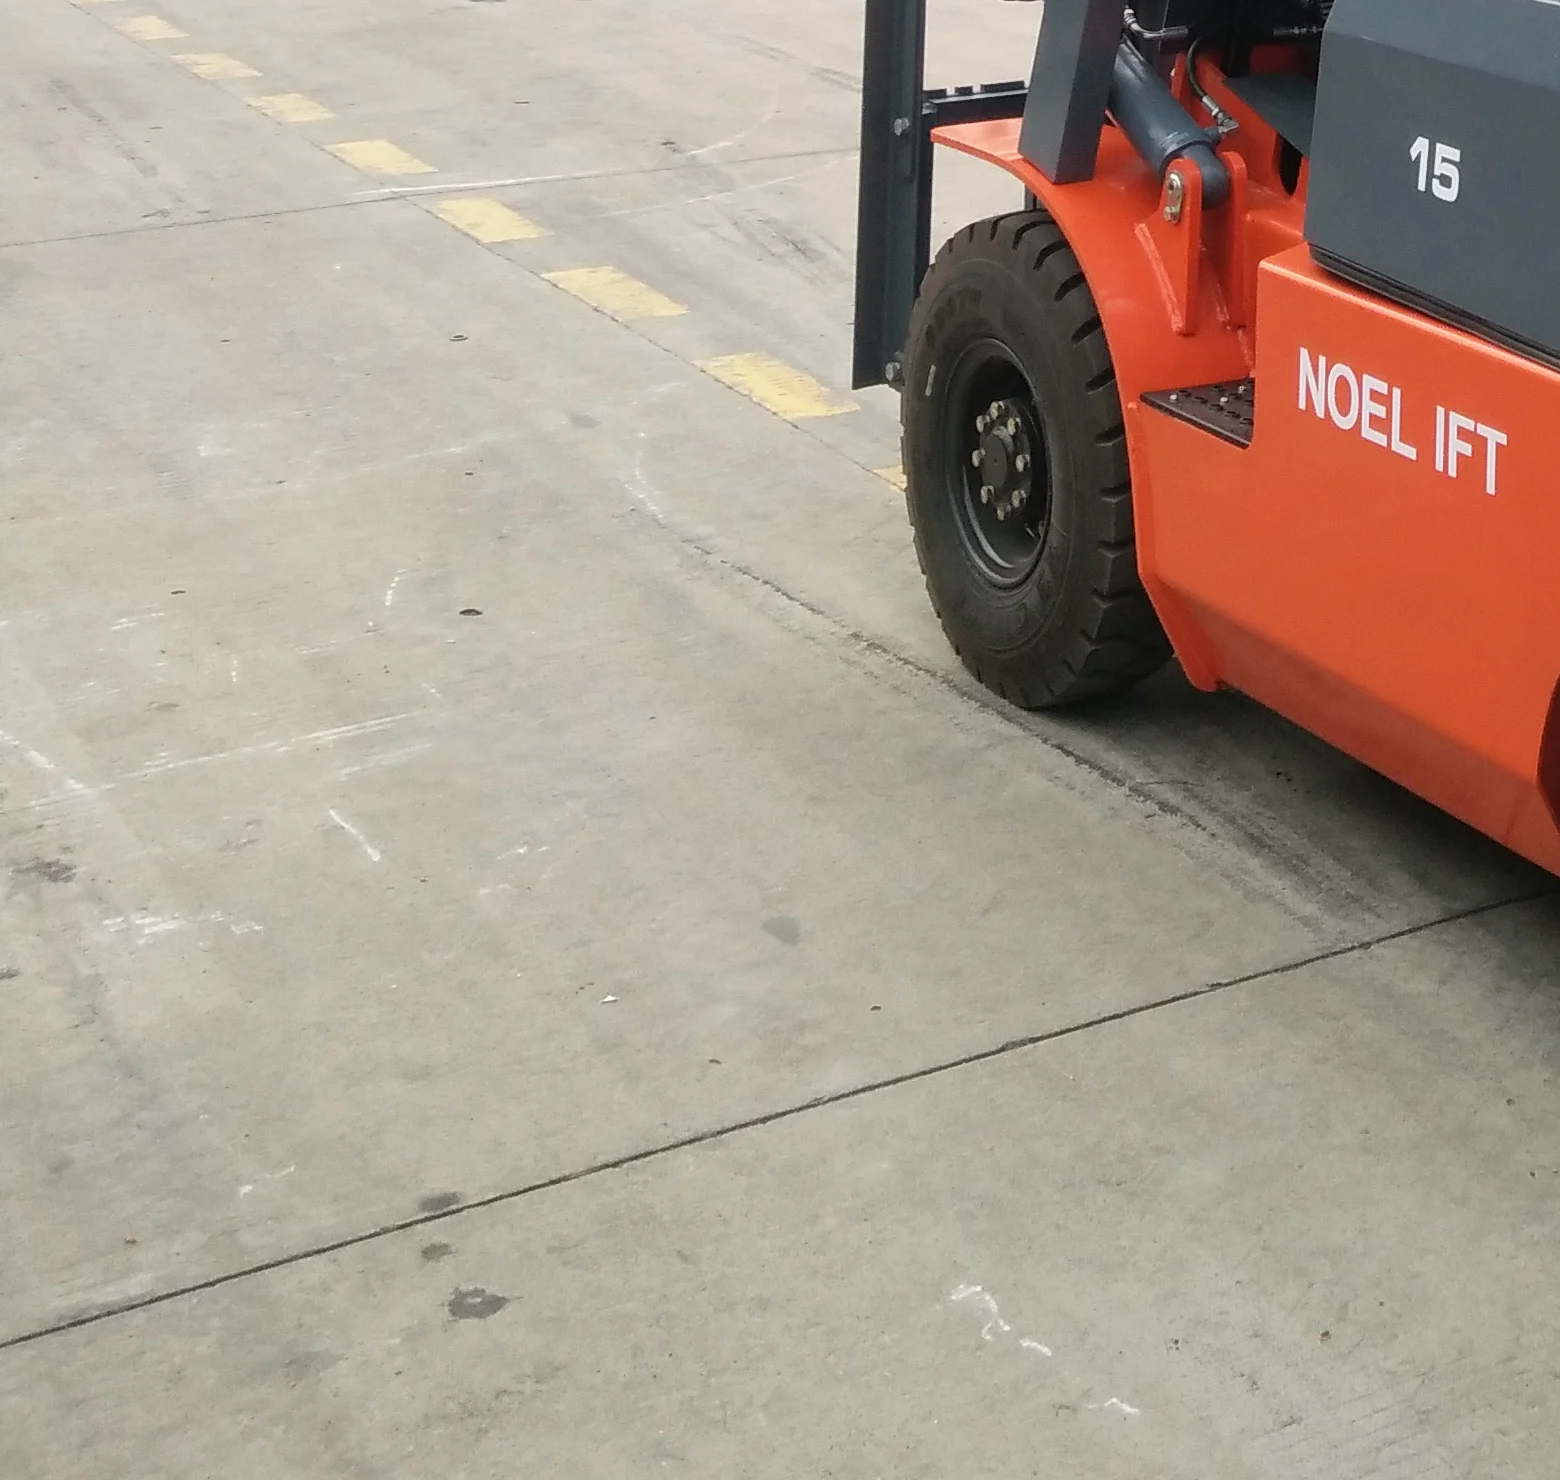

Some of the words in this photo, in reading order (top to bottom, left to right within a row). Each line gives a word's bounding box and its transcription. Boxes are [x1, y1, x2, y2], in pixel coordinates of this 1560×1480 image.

[1409, 135, 1461, 202] 15
[1298, 346, 1417, 461] NOEL
[1434, 405, 1508, 496] IFT
